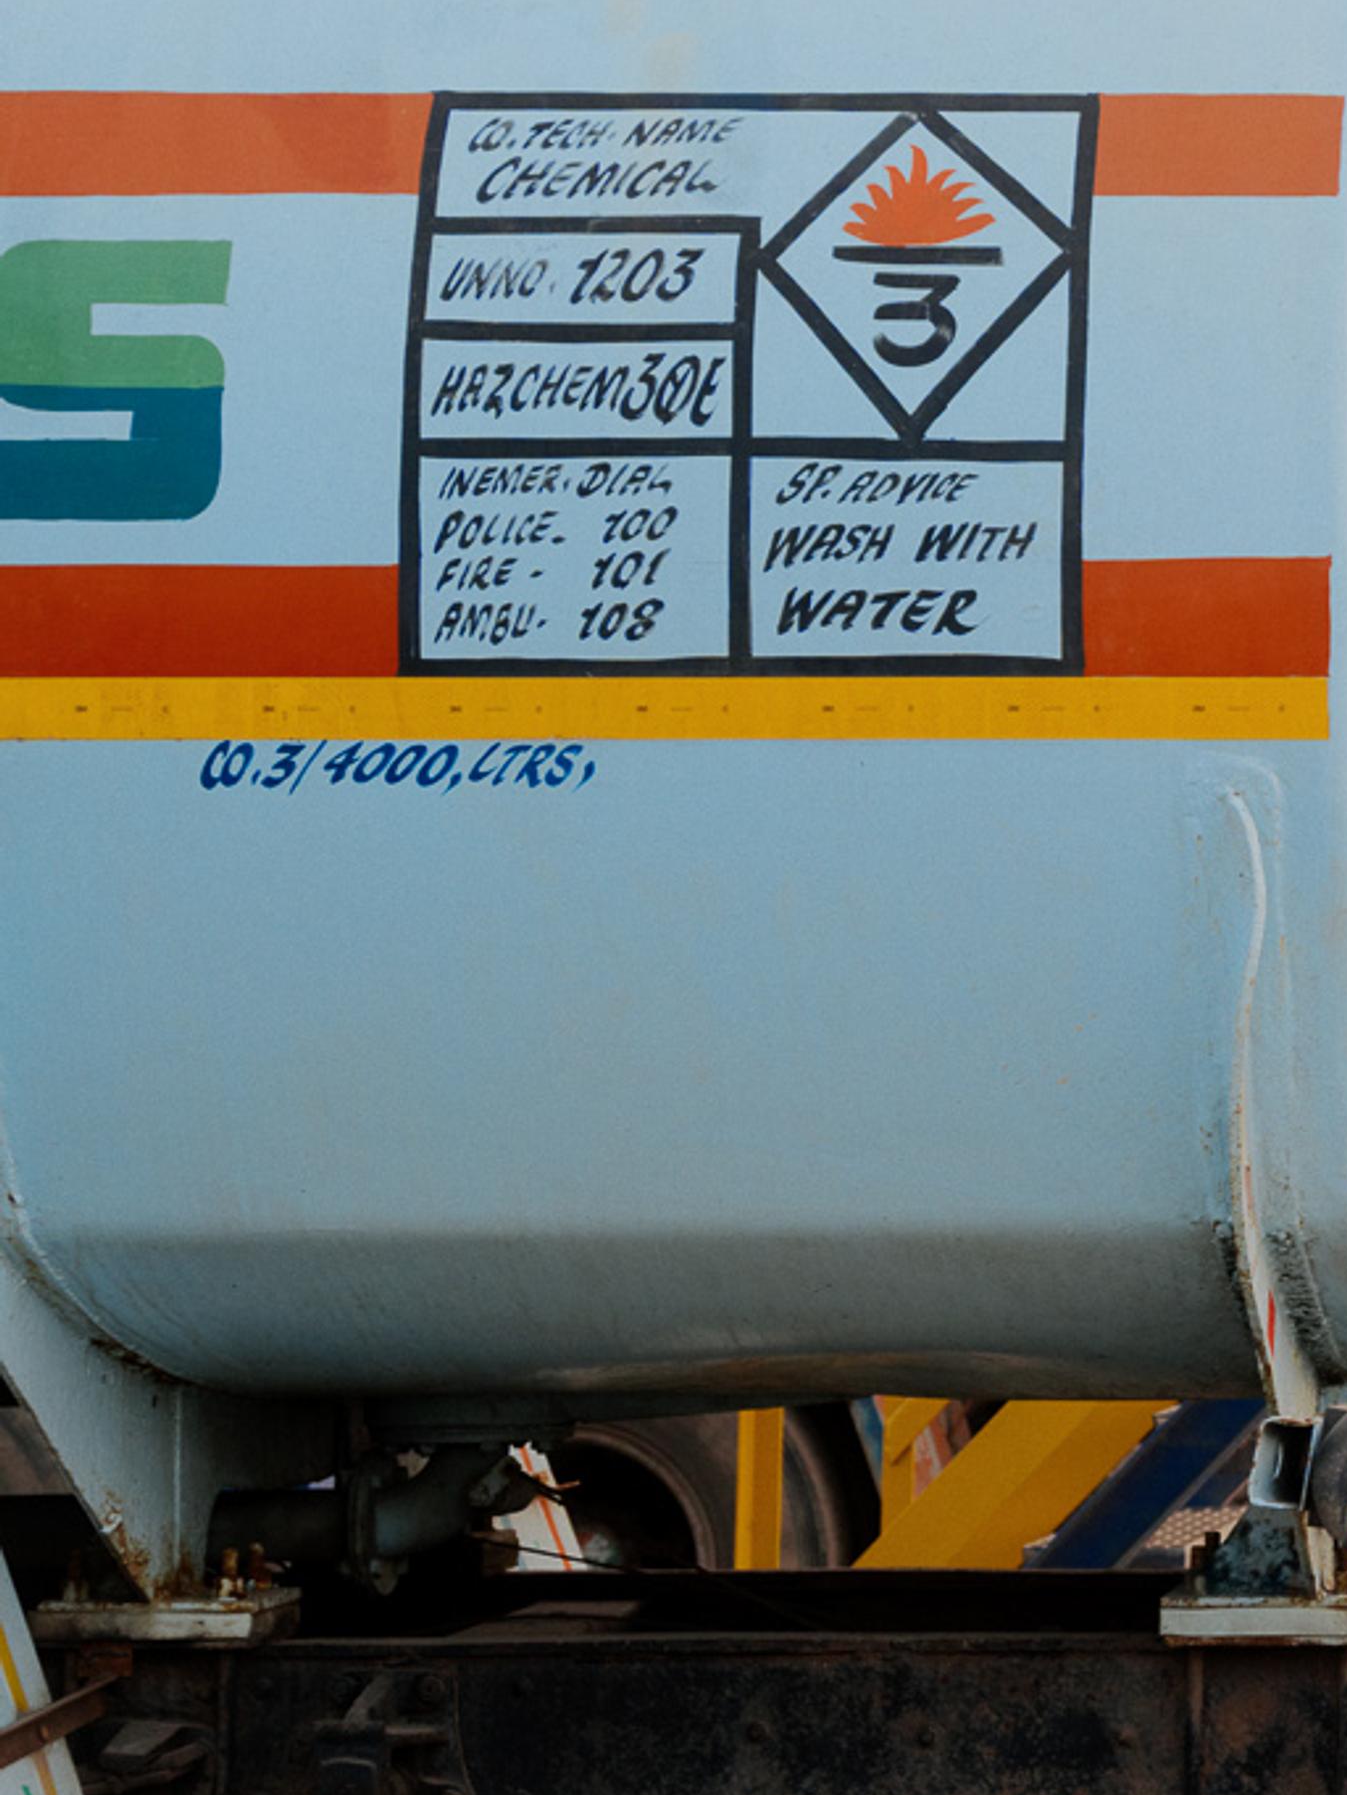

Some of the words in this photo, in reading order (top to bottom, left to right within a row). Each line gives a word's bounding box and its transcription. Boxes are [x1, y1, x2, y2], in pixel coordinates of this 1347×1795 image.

[622, 117, 743, 148] NAME
[475, 156, 720, 205] CHEMICAL
[569, 247, 706, 305] 1203
[872, 271, 961, 368] 3
[576, 462, 673, 499] DIAL
[837, 468, 980, 505] ADVICE
[603, 505, 679, 540] 100
[591, 548, 672, 591] 101
[763, 523, 896, 573] WASH
[914, 521, 1038, 564] WITH
[578, 597, 666, 642] 108
[776, 585, 982, 636] WATER
